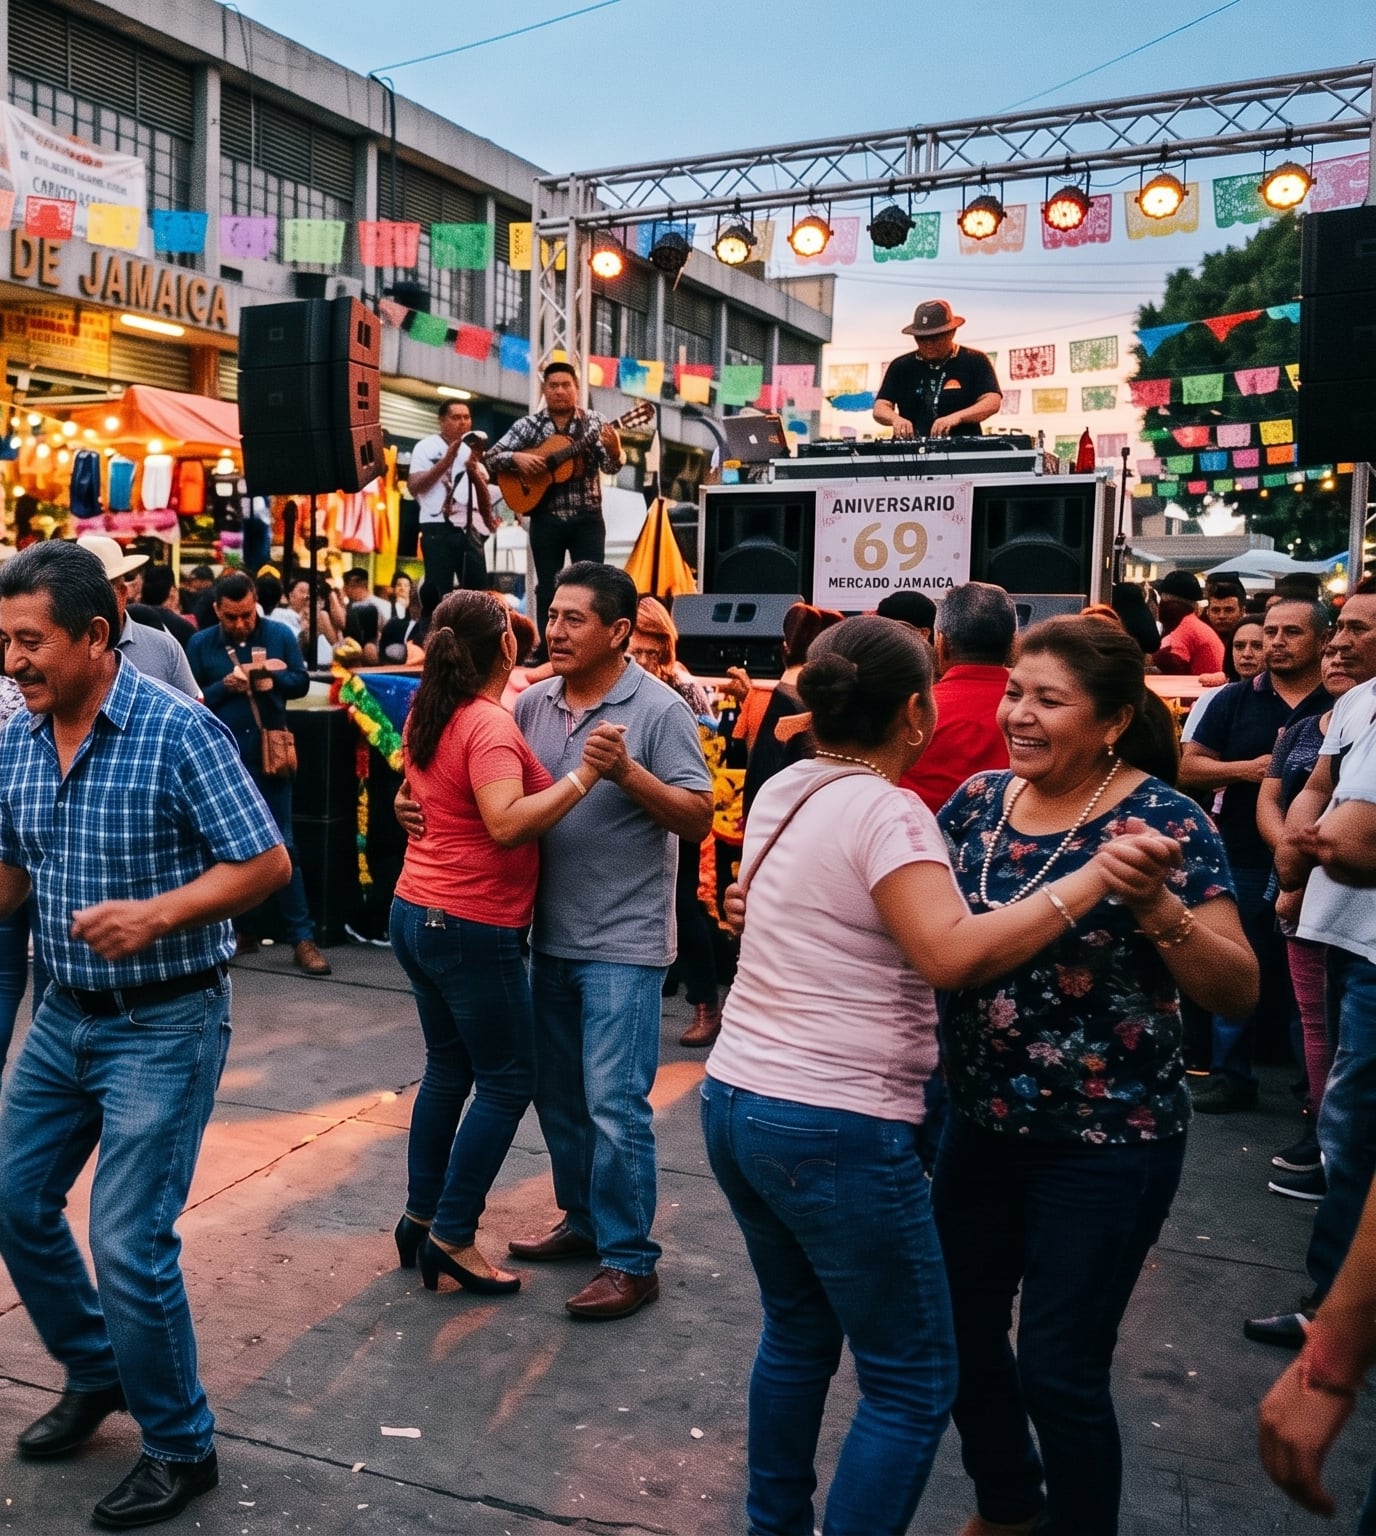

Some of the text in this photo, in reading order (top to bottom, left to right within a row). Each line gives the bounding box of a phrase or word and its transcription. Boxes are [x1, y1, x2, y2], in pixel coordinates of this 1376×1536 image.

[12, 228, 62, 287] DE
[81, 251, 230, 329] JAMAICA
[832, 495, 955, 514] ANIVERSARIO
[853, 521, 928, 572] 69
[828, 577, 954, 589] MERCADO JAMAICA
